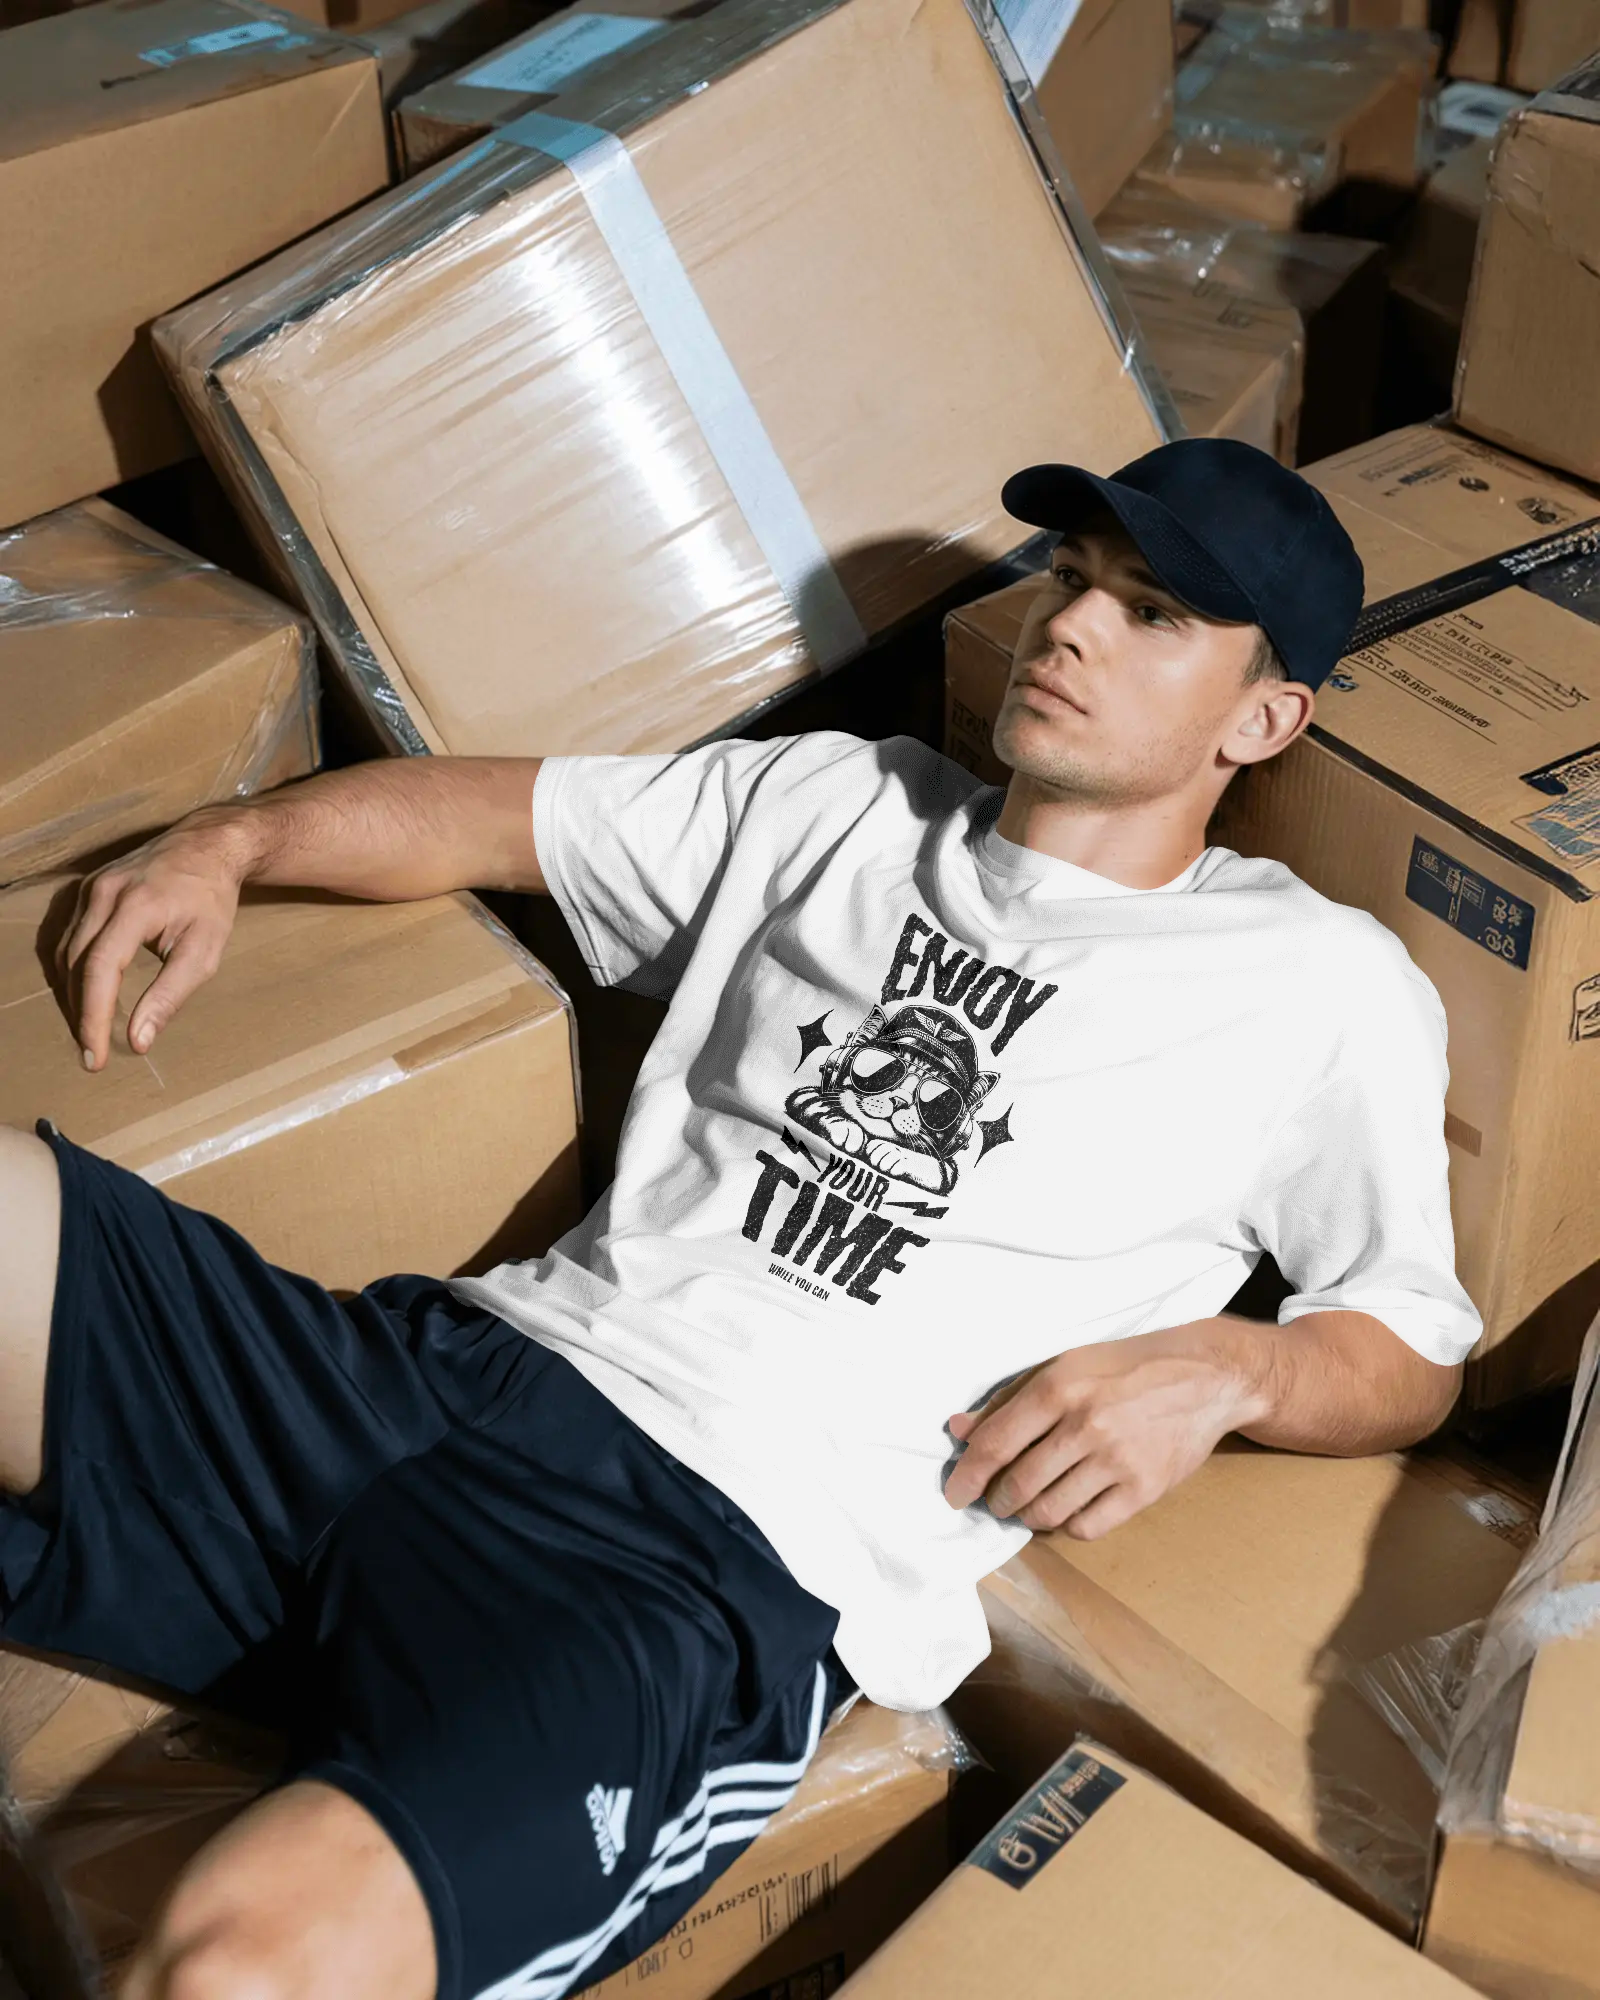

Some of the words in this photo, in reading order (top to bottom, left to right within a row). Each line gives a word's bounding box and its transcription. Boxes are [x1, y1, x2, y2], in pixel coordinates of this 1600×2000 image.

[881, 913, 1059, 1057] ENJOY
[742, 1150, 931, 1305] TIME
[817, 1153, 890, 1212] YOUR
[768, 1263, 795, 1283] WHILE
[794, 1276, 813, 1292] YOU
[811, 1285, 831, 1301] CAN
